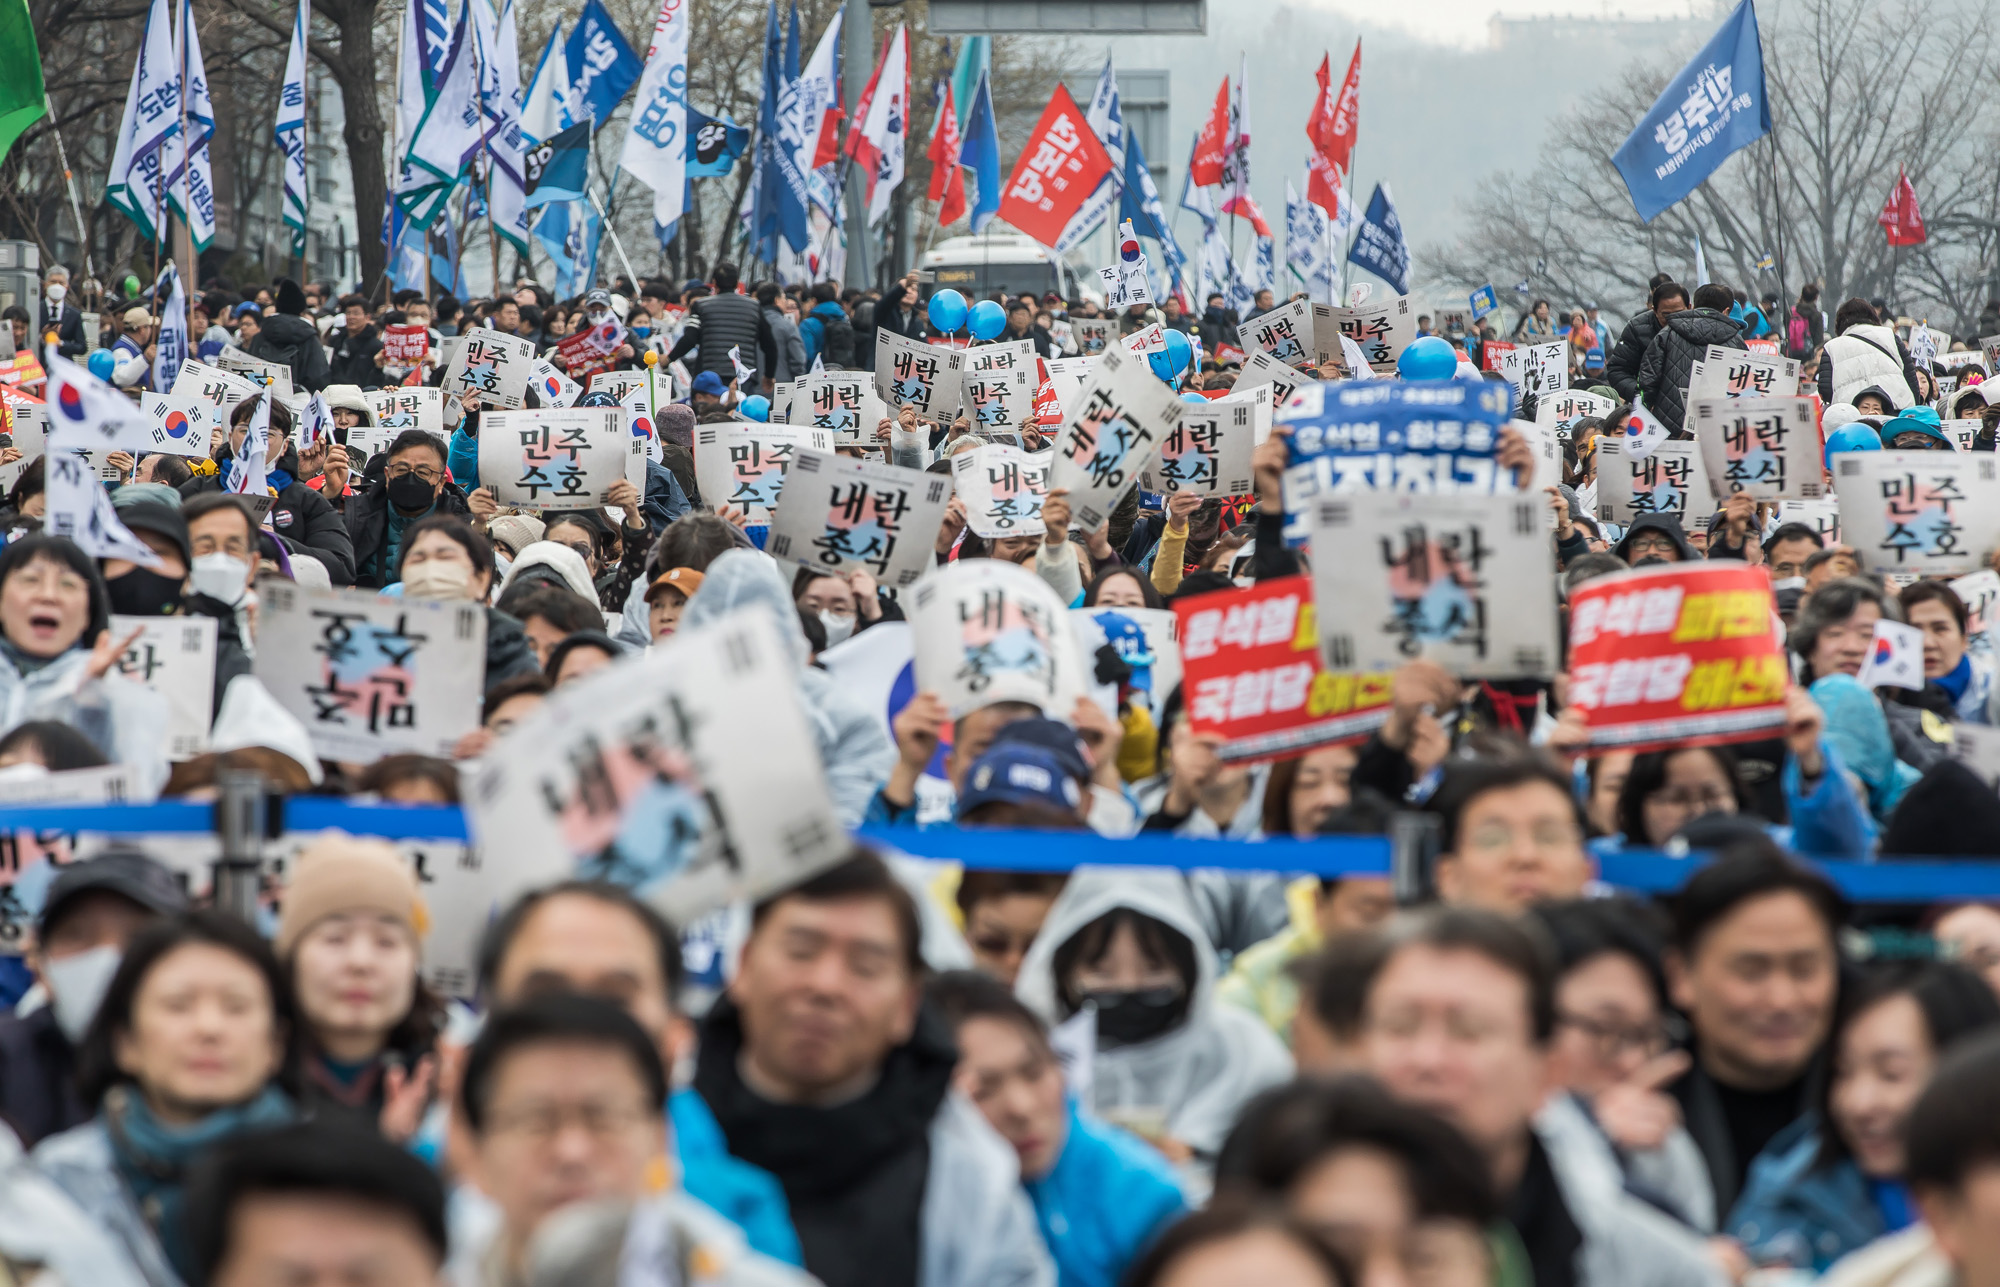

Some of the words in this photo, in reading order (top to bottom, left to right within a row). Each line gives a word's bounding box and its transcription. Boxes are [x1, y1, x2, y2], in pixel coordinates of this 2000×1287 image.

[1255, 318, 1295, 346] 내란
[1339, 316, 1393, 343] 민주
[467, 339, 509, 369] 민주
[893, 351, 940, 386] 내란
[1506, 353, 1518, 368] 자
[1545, 344, 1562, 359] 주
[203, 383, 229, 406] 내
[458, 367, 501, 395] 수호
[968, 382, 1012, 405] 민주
[1547, 372, 1562, 391] 립
[1728, 362, 1777, 393] 내란
[376, 395, 423, 415] 내란
[812, 383, 864, 411] 내란
[889, 379, 932, 413] 종식
[1555, 399, 1598, 420] 내란
[975, 406, 1013, 430] 수호
[1063, 388, 1122, 459] 내란
[1554, 419, 1573, 440] 종
[1723, 416, 1790, 454] 내란
[518, 425, 593, 460] 민주
[729, 440, 794, 476] 민주
[1086, 413, 1153, 488] 종식
[515, 465, 591, 500] 수호
[988, 461, 1049, 496] 내란
[1159, 457, 1220, 492] 종식
[1630, 455, 1694, 489] 내란
[1723, 456, 1786, 493] 종식
[829, 480, 911, 532] 내란
[1627, 491, 1688, 521] 종식
[1881, 472, 1967, 516] 민주
[811, 526, 897, 576] 종식
[1379, 524, 1496, 590] 내란
[1880, 520, 1968, 563] 수호
[1185, 595, 1300, 660] 윤석열
[1380, 596, 1489, 659] 종식
[1571, 587, 1686, 647] 윤석열
[1671, 590, 1772, 645] 파면
[310, 608, 429, 663] 수호
[1193, 663, 1315, 723] 국힘당
[1570, 652, 1692, 711] 국힘당
[304, 671, 417, 734] 민주
